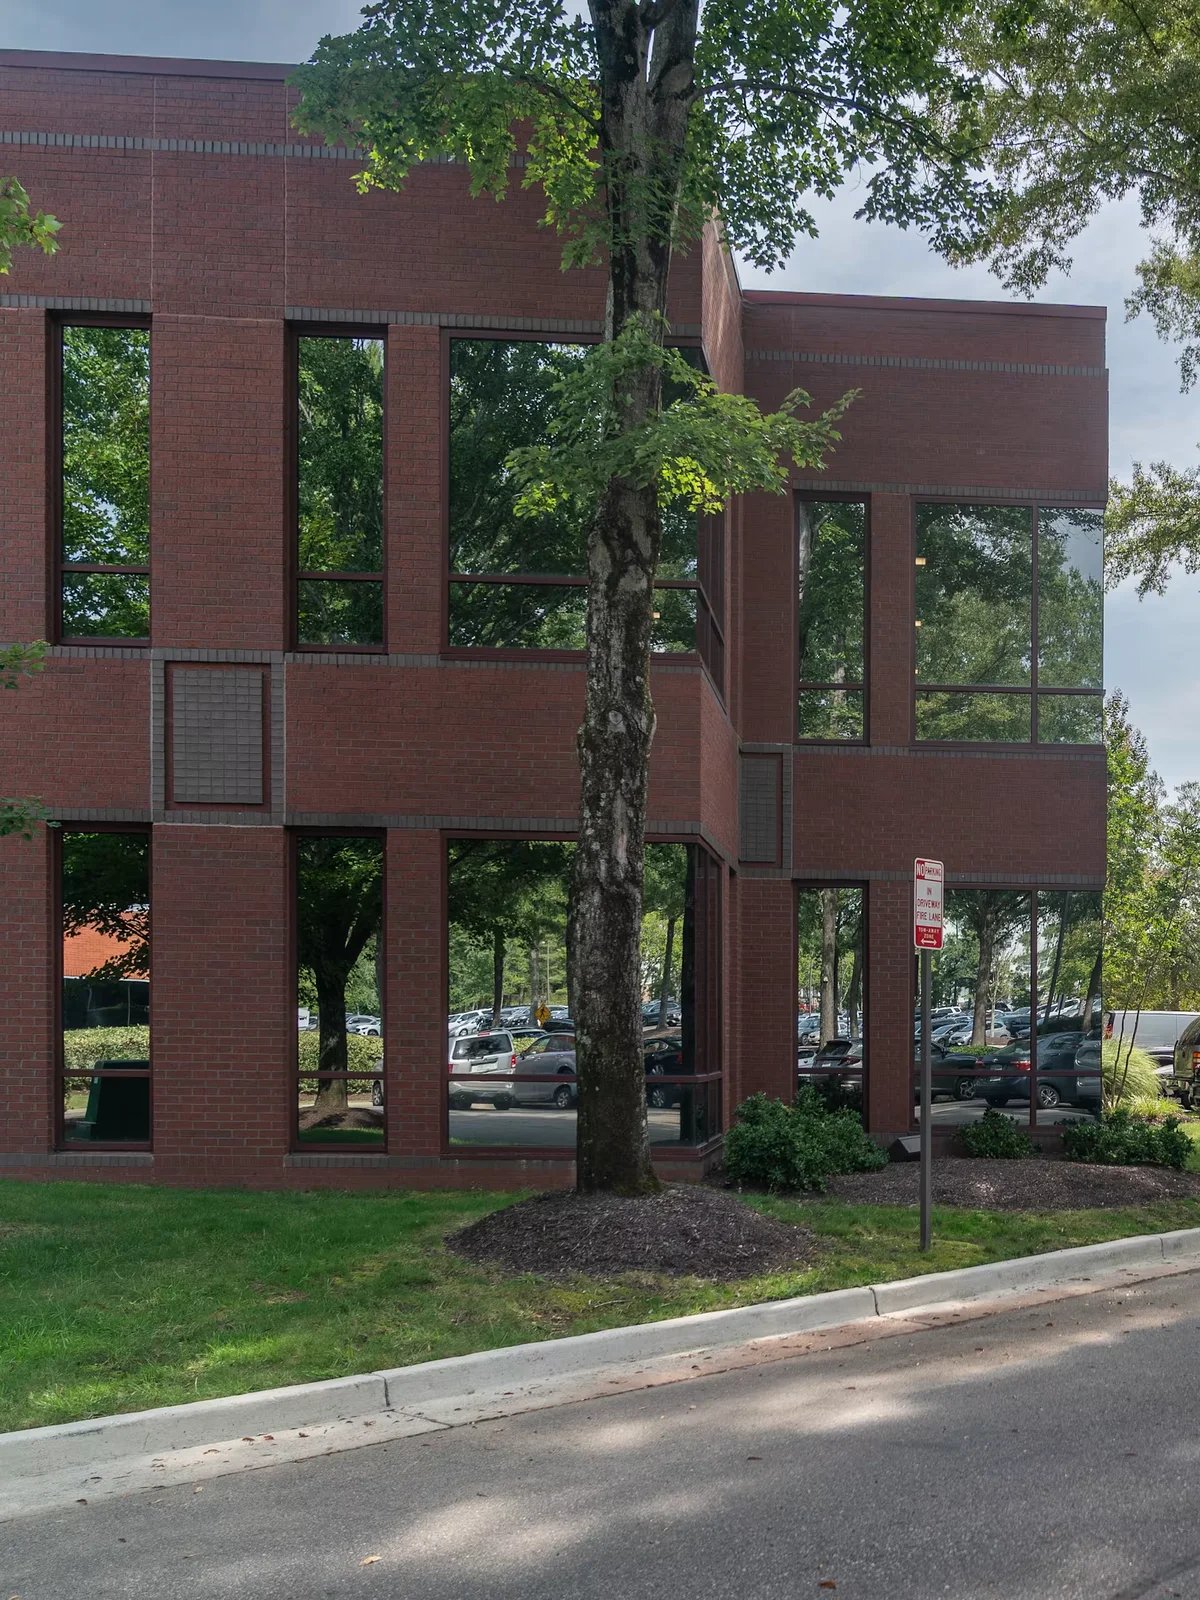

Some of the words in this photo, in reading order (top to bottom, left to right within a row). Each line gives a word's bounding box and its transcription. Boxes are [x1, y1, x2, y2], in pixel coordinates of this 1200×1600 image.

[916, 863, 925, 876] NO
[925, 866, 941, 877] PARKING
[917, 899, 940, 909] DRIVEWAY
[916, 911, 927, 920] FIRE
[929, 912, 941, 922] LANE
